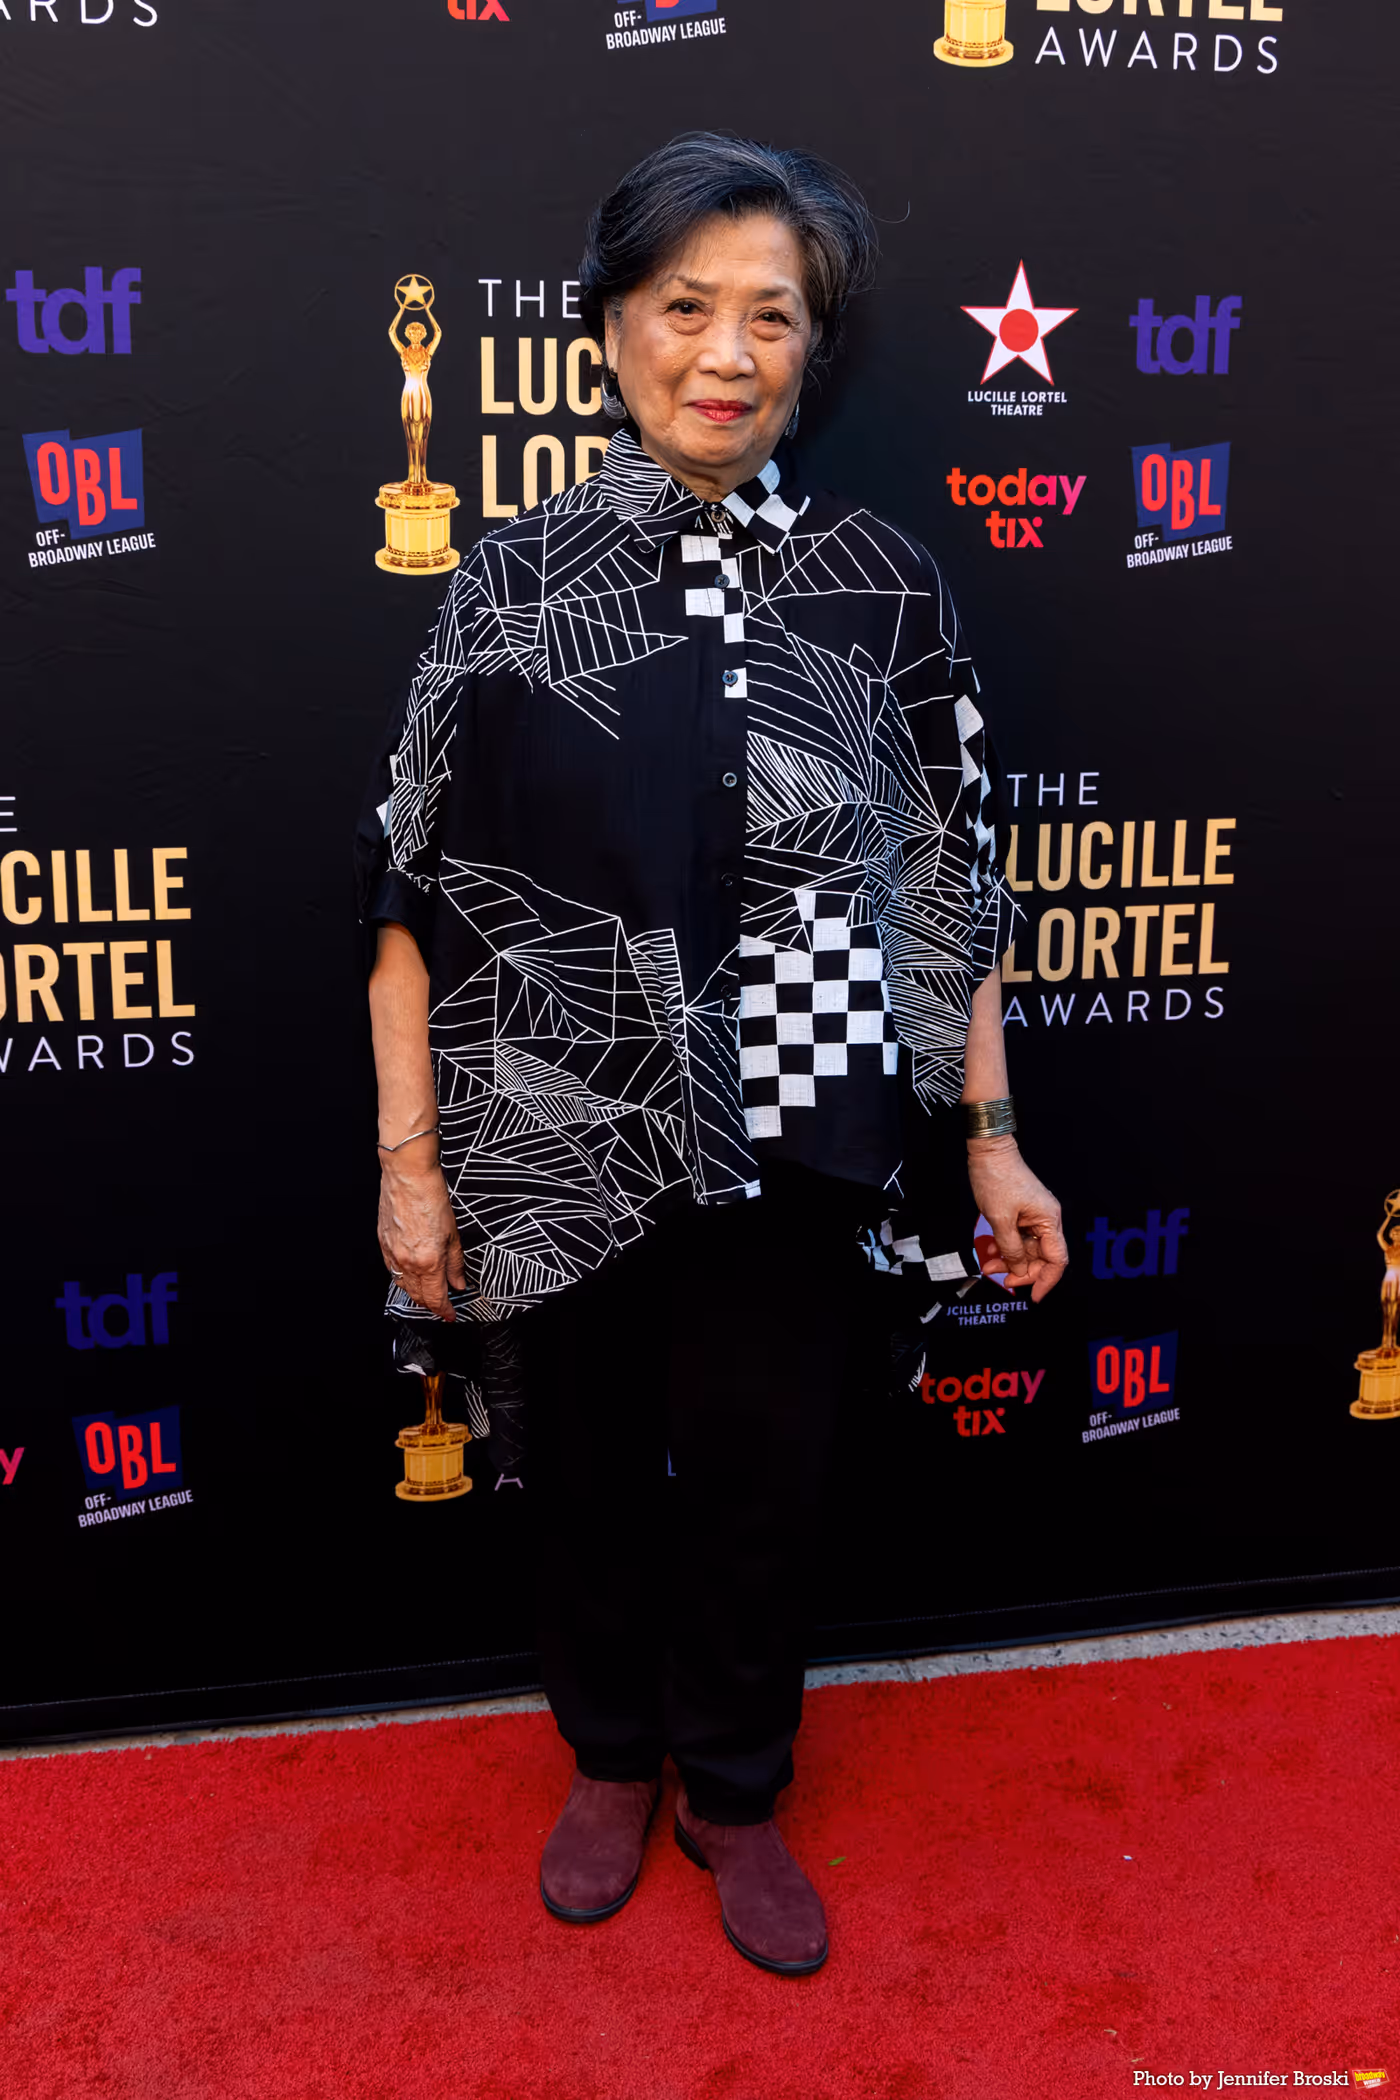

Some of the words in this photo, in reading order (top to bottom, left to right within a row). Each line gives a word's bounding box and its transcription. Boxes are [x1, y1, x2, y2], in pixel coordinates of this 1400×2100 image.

[606, 25, 677, 50] BROADWAY
[680, 17, 727, 40] LEAGUE
[614, 10, 642, 29] OFF-
[1035, 26, 1278, 74] AWARDS
[5, 266, 142, 355] tdf
[478, 279, 581, 318] THE
[1129, 295, 1243, 375] tdf
[968, 391, 1016, 403] LUCILLE
[1021, 391, 1067, 403] LORTEL
[991, 404, 1043, 416] THEATRE
[37, 441, 138, 527] OBL
[946, 467, 1087, 515] today
[1141, 453, 1221, 530] OBL
[36, 529, 65, 547] OFF-
[985, 510, 1044, 549] tix
[1134, 533, 1159, 549] OFF-
[28, 541, 104, 568] BROADWAY
[106, 533, 156, 556] LEAGUE
[1126, 544, 1189, 568] BROADWAY
[1191, 536, 1233, 557] LEAGUE
[1007, 772, 1099, 807] THE
[1005, 818, 1236, 892] LUCILLE
[0, 940, 196, 1023] RTEL
[1002, 986, 1224, 1027] AWARDS
[1085, 1207, 1190, 1279] tdf
[54, 1271, 178, 1350] tdf
[958, 1314, 1006, 1326] THEATRE
[986, 1301, 1028, 1313] LORTEL
[918, 1367, 1046, 1404] today
[1097, 1345, 1170, 1408] OBL
[953, 1405, 1006, 1437] tix
[1082, 1417, 1140, 1444] BROADWAY
[1142, 1407, 1181, 1428] LEAGUE
[1089, 1411, 1112, 1427] OFF-
[84, 1421, 176, 1490] OBL
[78, 1500, 146, 1528] BROADWAY
[148, 1489, 194, 1512] LEAGUE
[85, 1493, 111, 1510] OFF-
